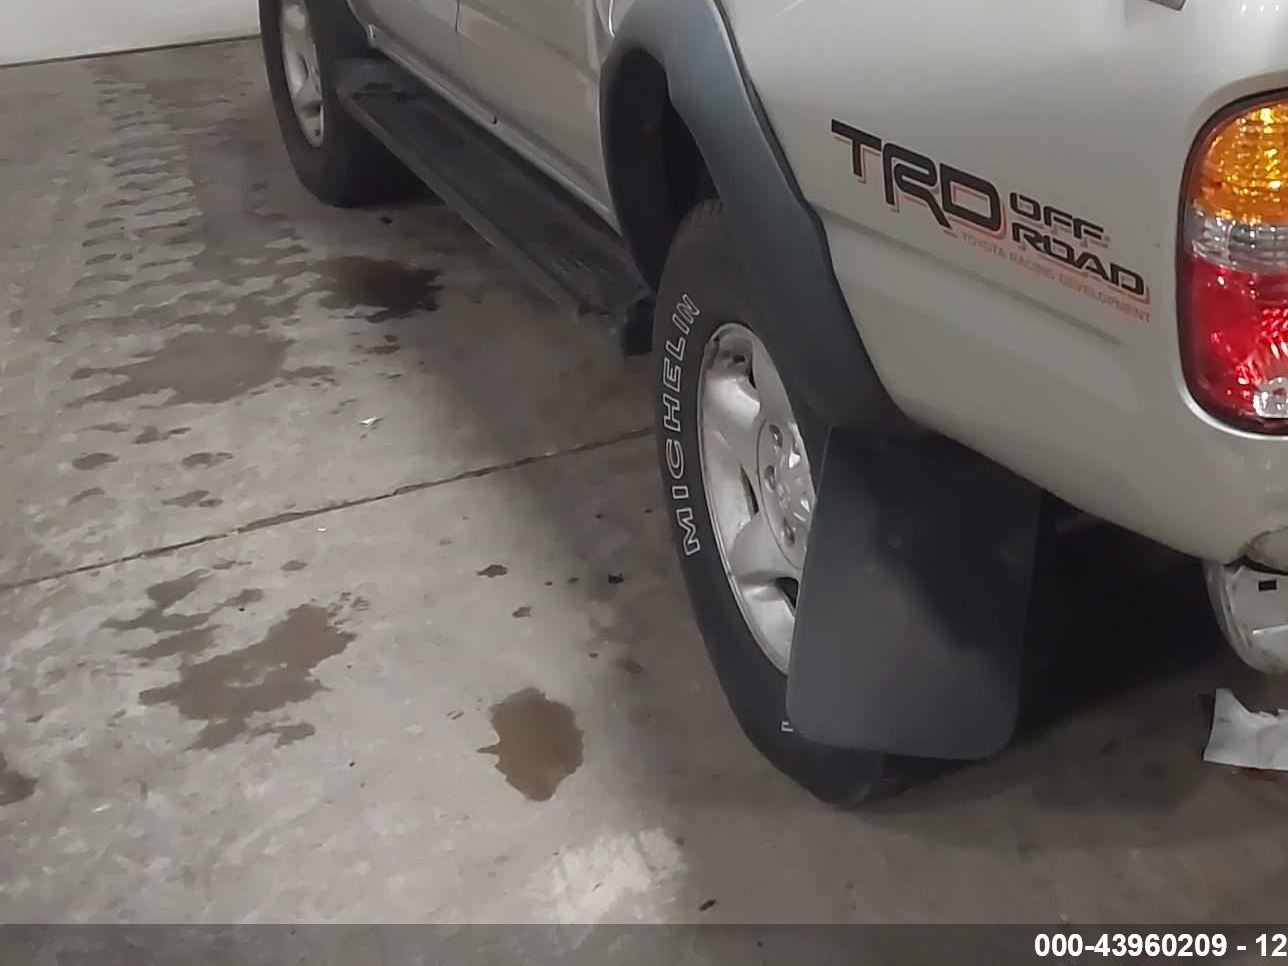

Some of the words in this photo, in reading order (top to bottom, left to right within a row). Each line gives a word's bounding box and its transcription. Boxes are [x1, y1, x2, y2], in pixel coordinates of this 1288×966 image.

[830, 118, 1004, 238] TRD
[1009, 191, 1106, 244] OFF
[961, 232, 1006, 259] TOYOTA
[1057, 273, 1152, 324] DEVELOPMENT
[1011, 221, 1148, 300] ROAD
[662, 293, 701, 557] MICHELIN
